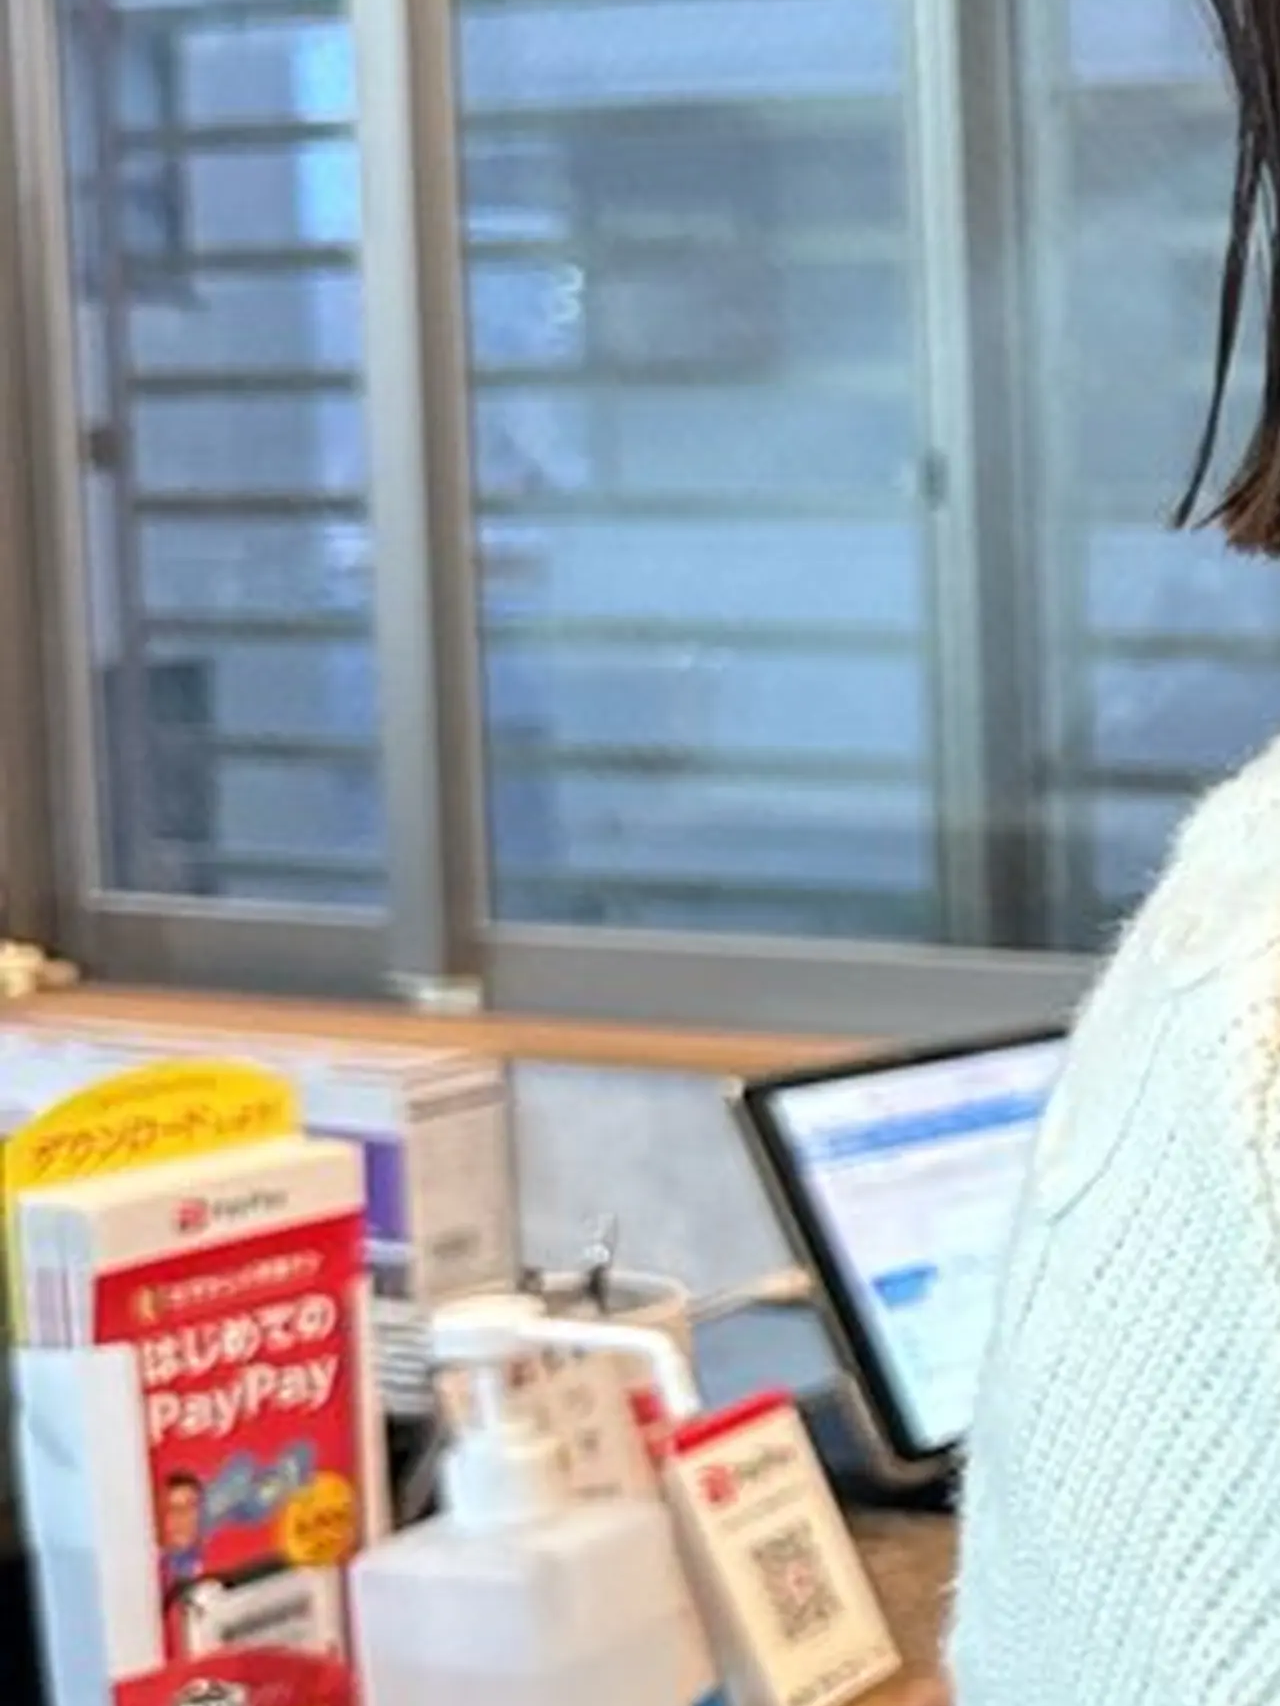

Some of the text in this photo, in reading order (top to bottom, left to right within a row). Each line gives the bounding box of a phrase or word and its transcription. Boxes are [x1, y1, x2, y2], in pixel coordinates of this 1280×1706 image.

[140, 1291, 340, 1387] はじめての
[148, 1353, 340, 1447] PayPay
